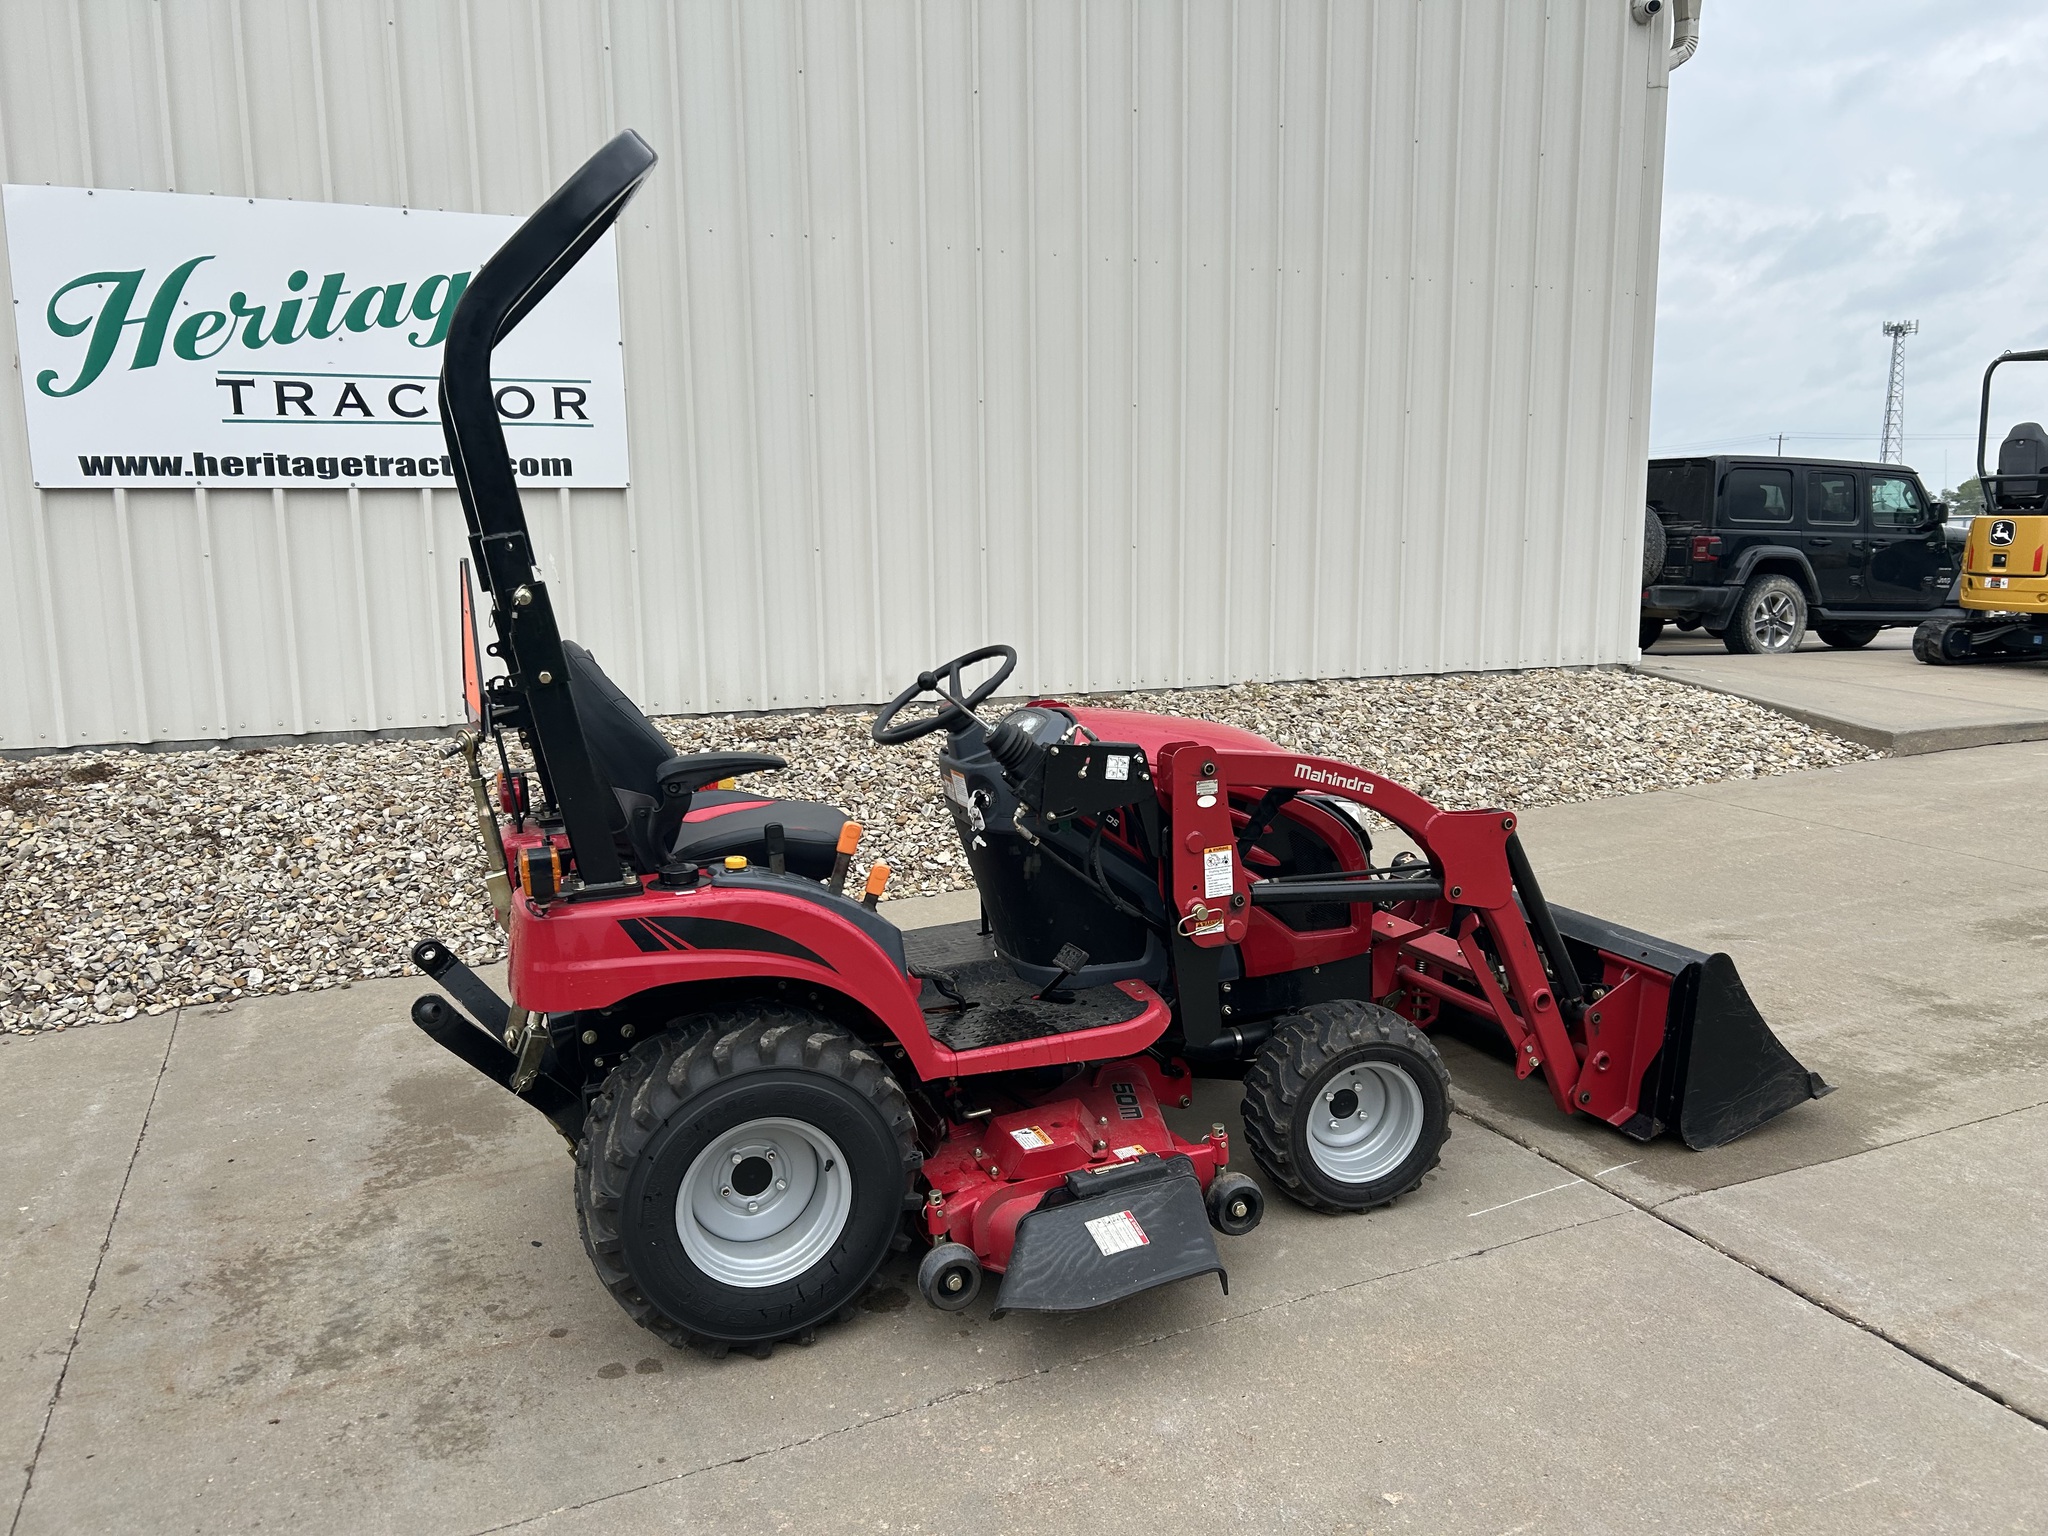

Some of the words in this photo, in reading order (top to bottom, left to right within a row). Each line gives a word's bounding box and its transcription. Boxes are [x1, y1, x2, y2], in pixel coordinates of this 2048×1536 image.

[37, 254, 473, 398] Heritag
[216, 377, 590, 420] TRACOR
[78, 451, 573, 480] www.heritagetractom
[1294, 763, 1375, 795] Mahindra
